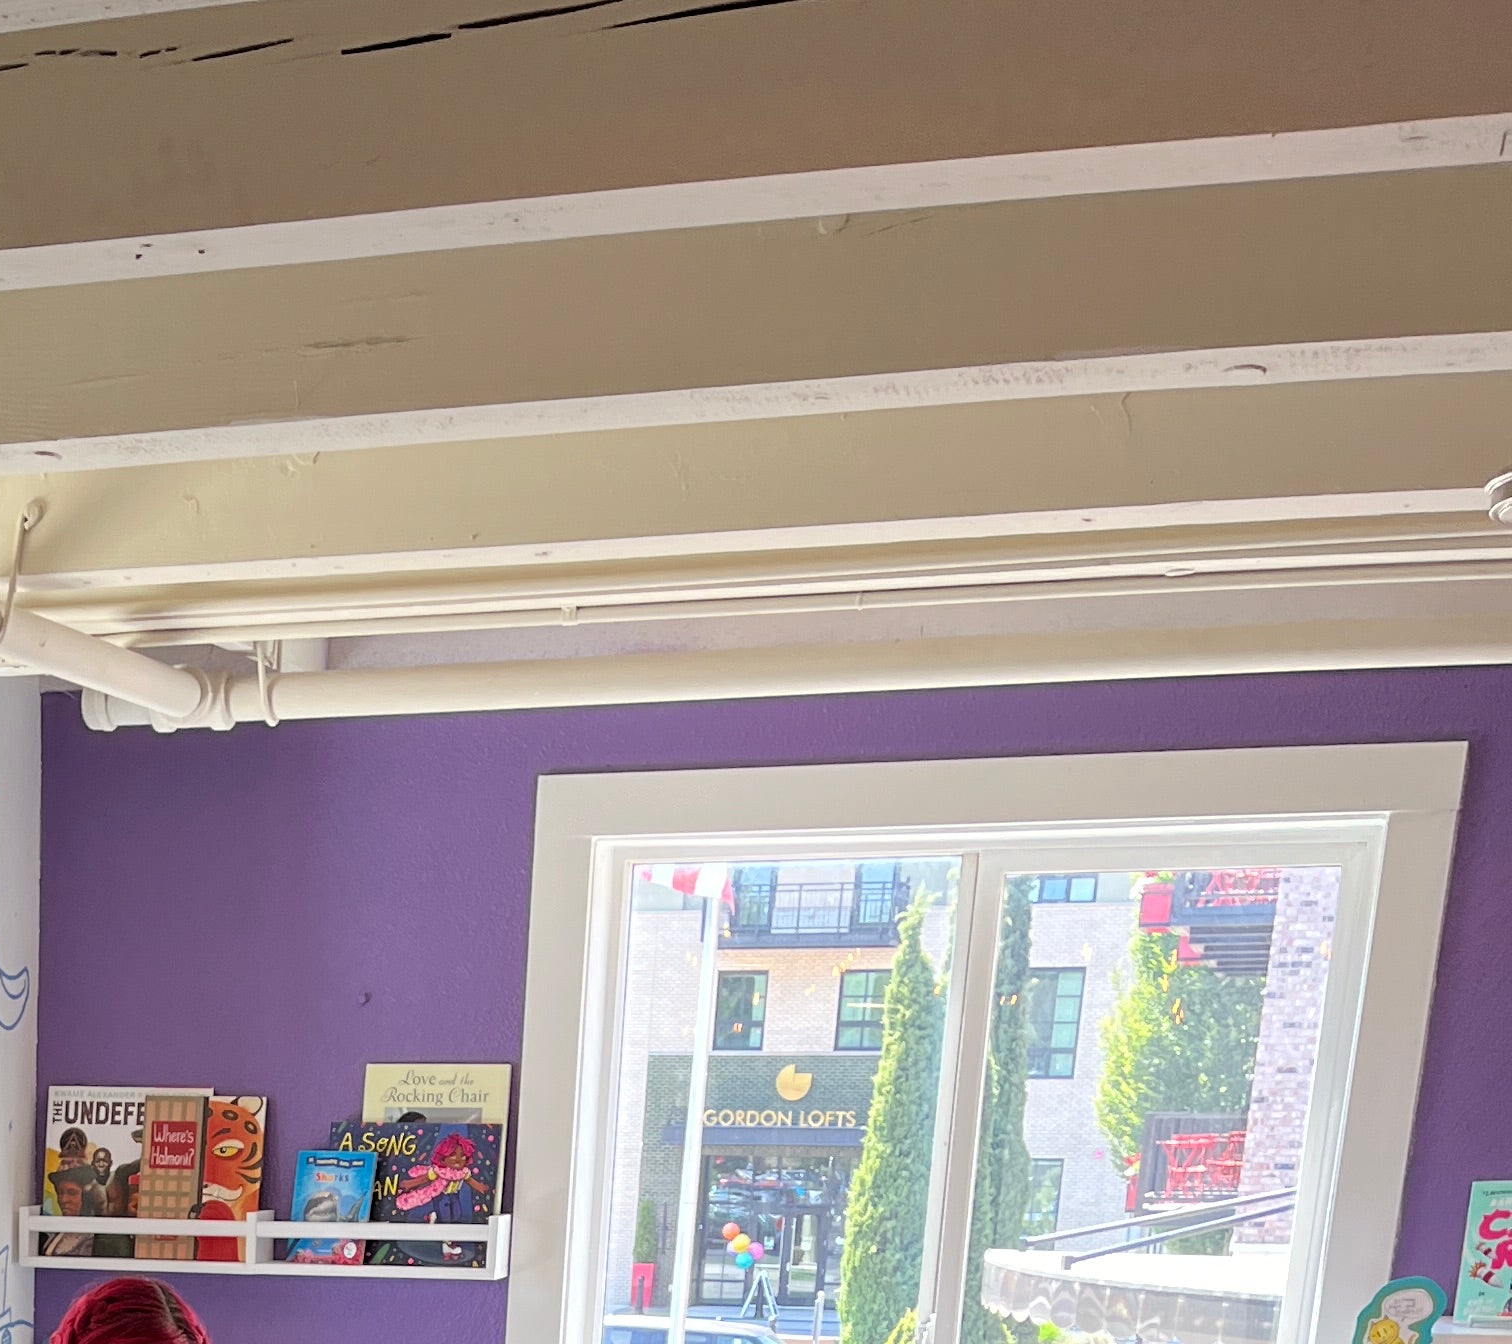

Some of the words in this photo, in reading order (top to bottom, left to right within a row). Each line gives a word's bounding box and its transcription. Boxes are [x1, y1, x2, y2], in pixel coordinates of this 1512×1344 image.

[399, 1070, 436, 1085] Love
[439, 1074, 456, 1084] and
[460, 1073, 474, 1085] the
[382, 1086, 443, 1106] Rocking
[448, 1088, 489, 1103] Chair
[52, 1101, 63, 1124] THE
[703, 1109, 792, 1127] GORDON
[799, 1110, 856, 1128] LOFTS
[153, 1123, 194, 1144] Where's
[339, 1132, 353, 1152] A
[151, 1146, 195, 1167] Halmoni?
[315, 1172, 350, 1182] Sharks
